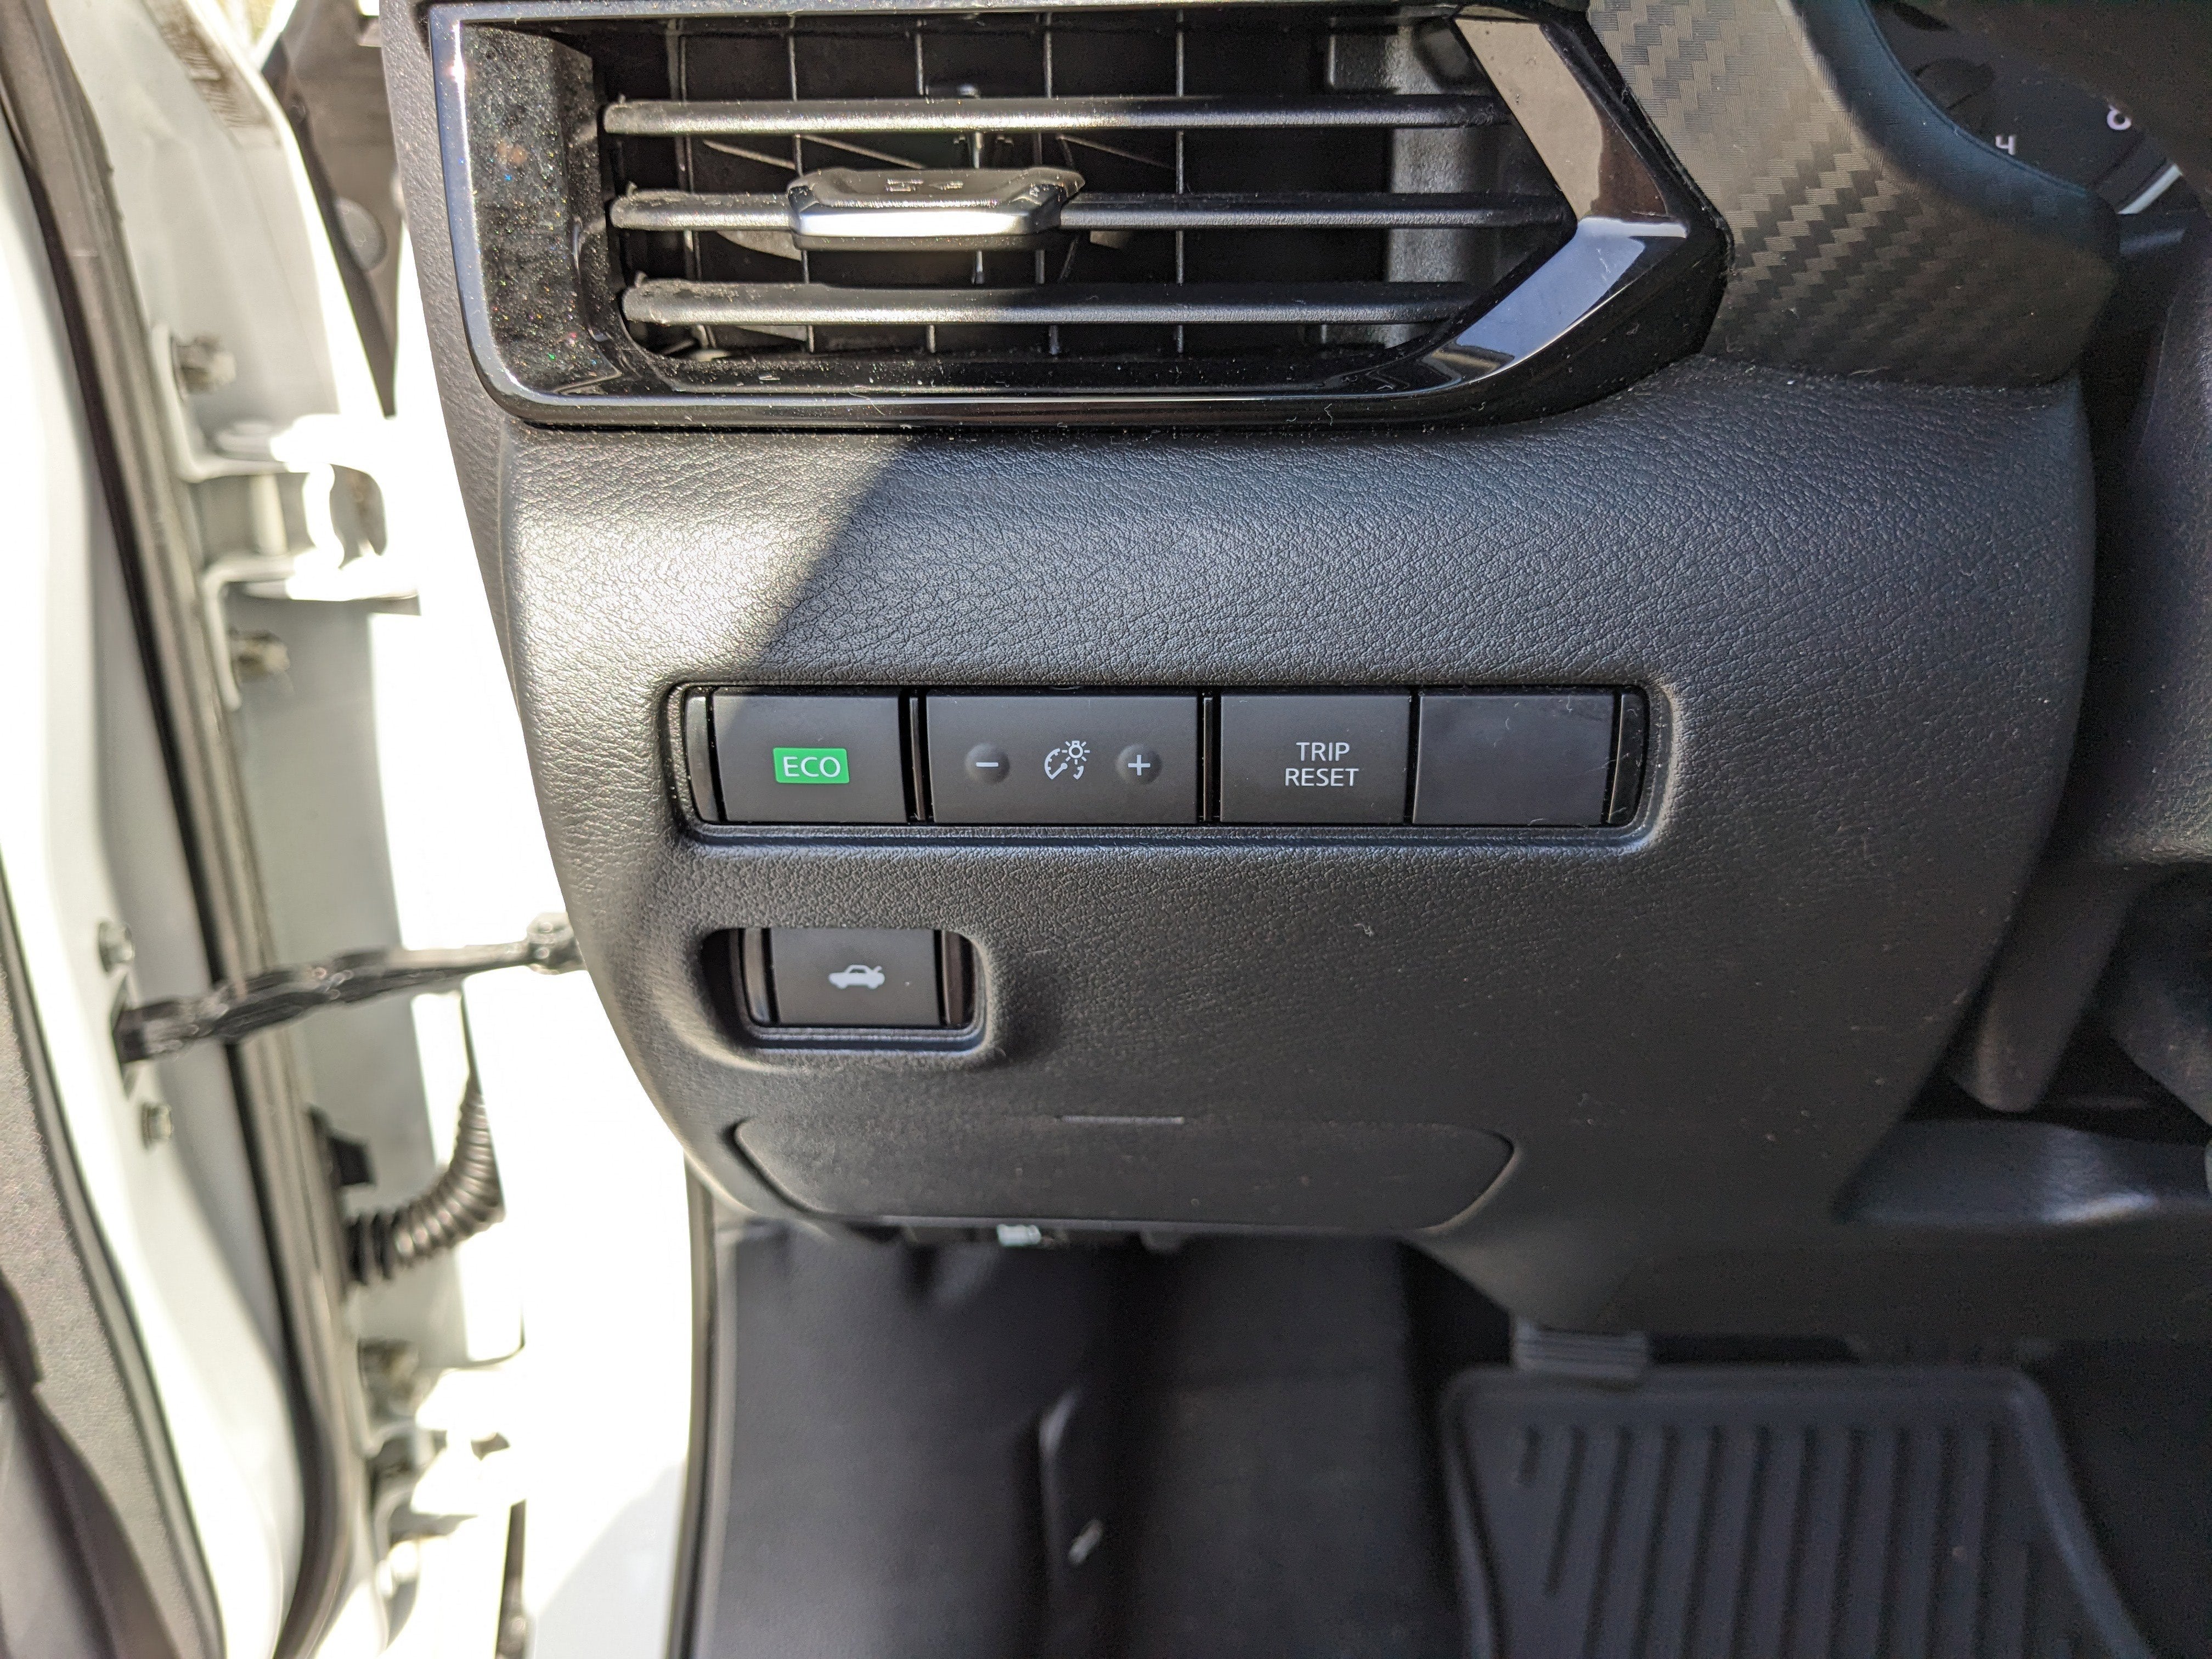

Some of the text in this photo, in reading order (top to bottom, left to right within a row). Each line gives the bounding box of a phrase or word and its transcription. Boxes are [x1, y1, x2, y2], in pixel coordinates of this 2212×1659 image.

[1995, 134, 2016, 156] 4
[1296, 742, 1350, 761] TRIP
[783, 756, 841, 778] ECO
[1285, 768, 1359, 787] RESET
